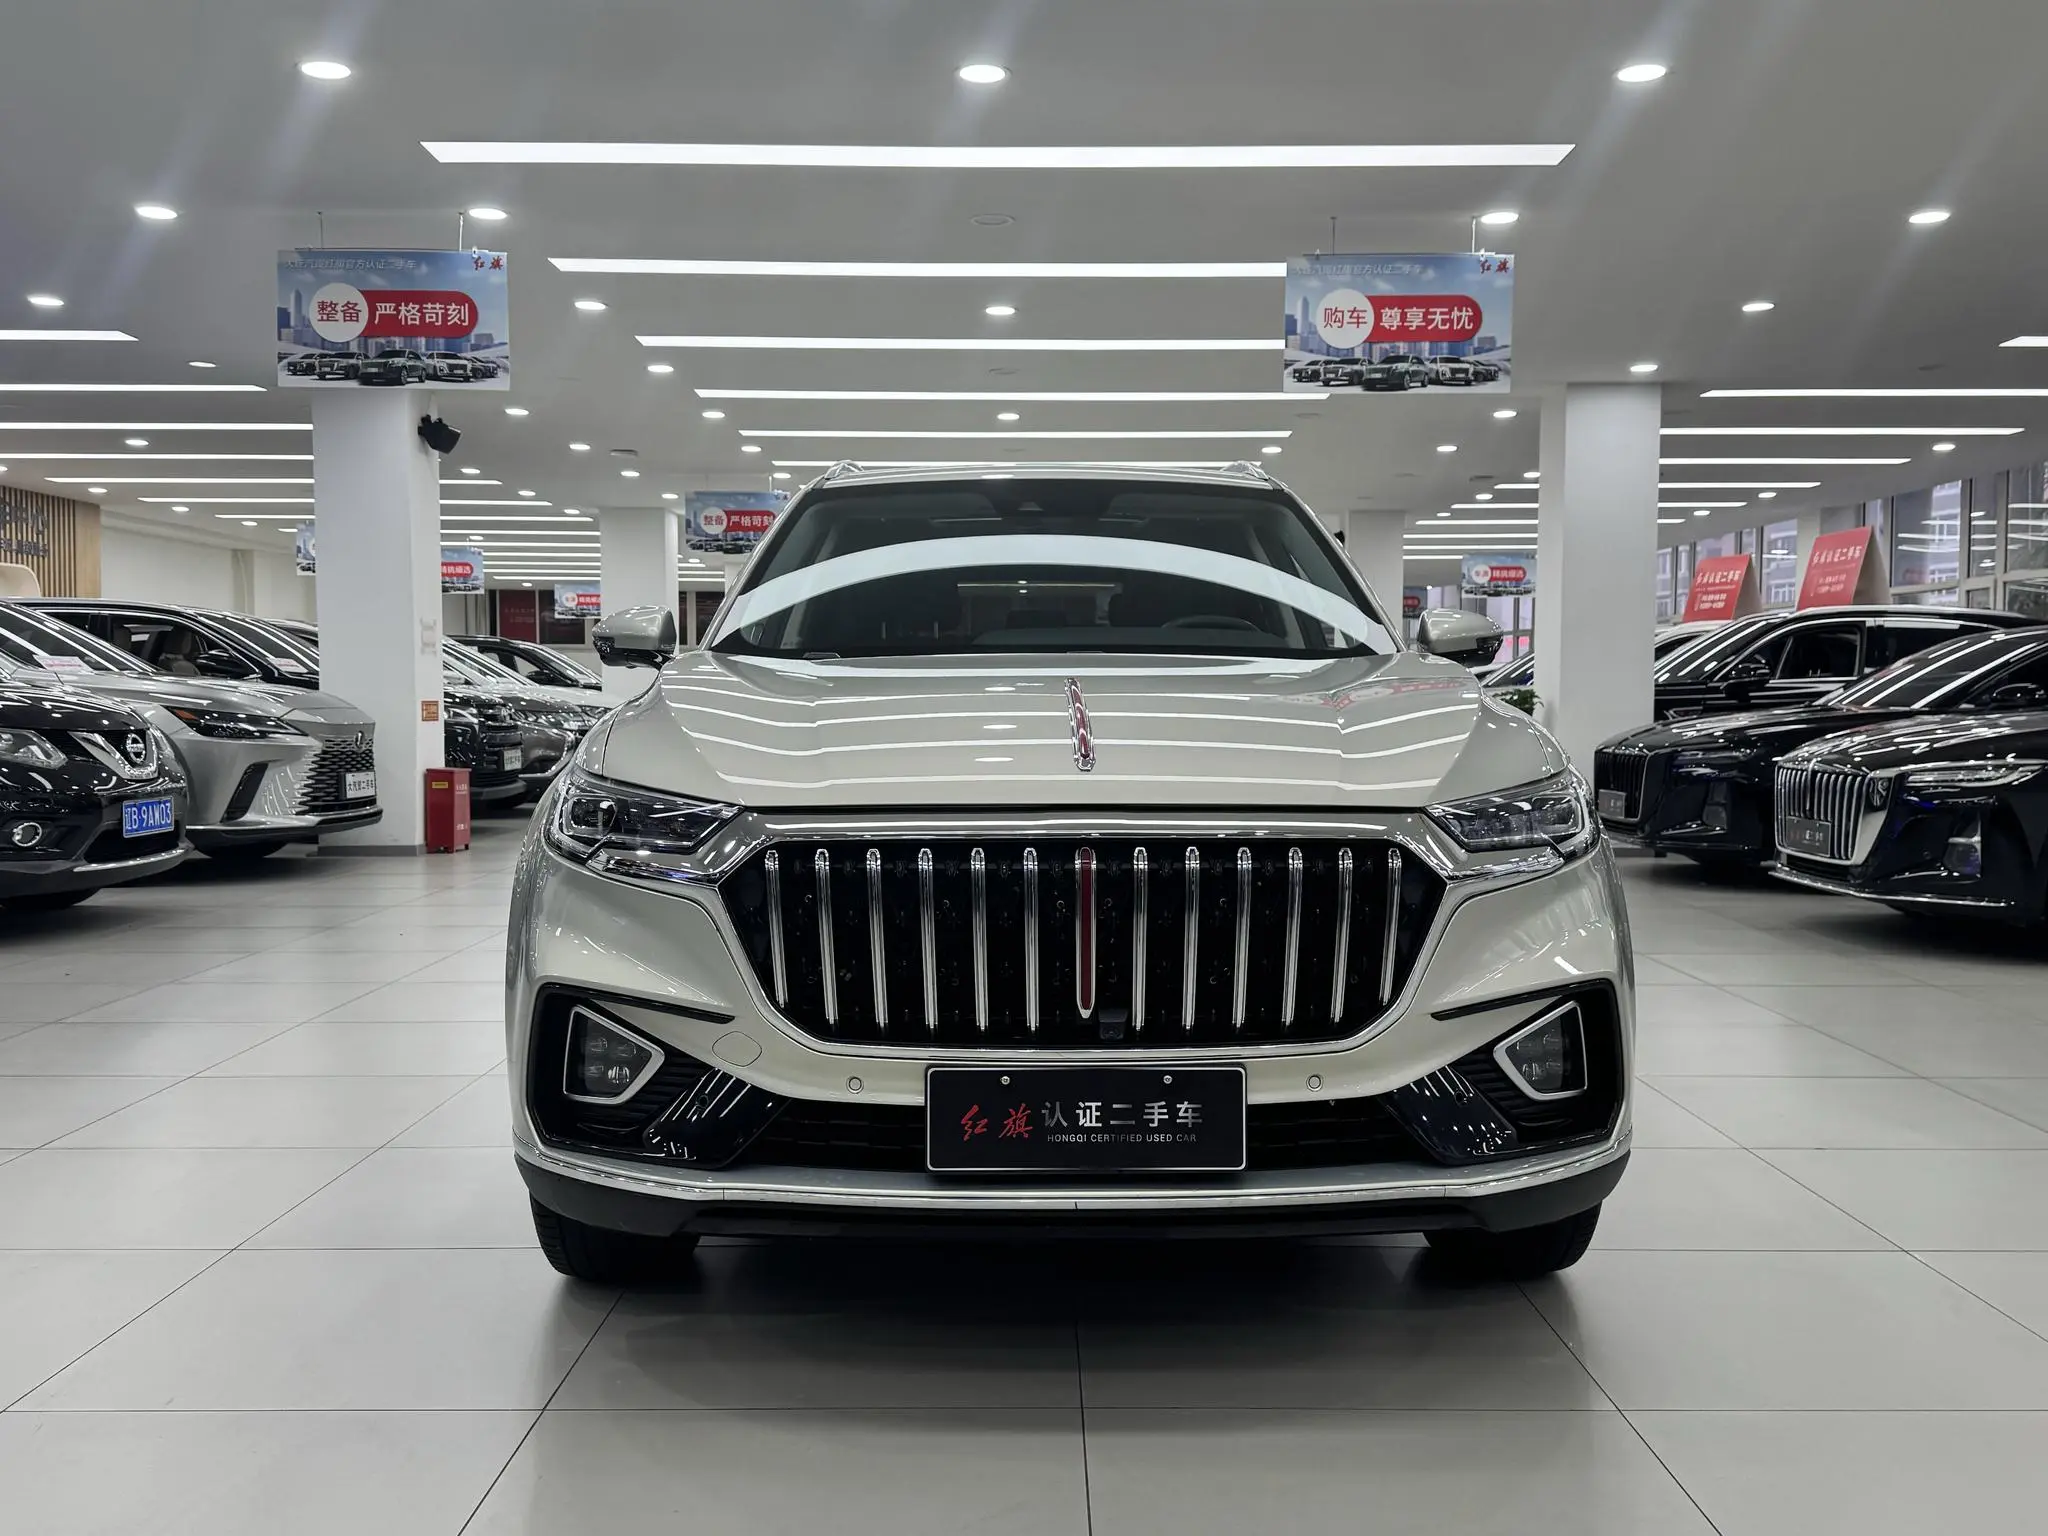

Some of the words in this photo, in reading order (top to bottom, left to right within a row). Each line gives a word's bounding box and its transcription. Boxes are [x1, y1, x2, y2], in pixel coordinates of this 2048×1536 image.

[317, 300, 362, 323] 整备
[374, 302, 469, 327] 严格苛刻
[1323, 307, 1368, 329] 购车
[1380, 307, 1474, 331] 尊享无忧
[703, 514, 724, 526] 整备
[1047, 1134, 1087, 1143] HONGQI
[1090, 1134, 1142, 1142] CERTIFIED
[1146, 1134, 1173, 1142] USED
[1176, 1134, 1197, 1142] CAR
